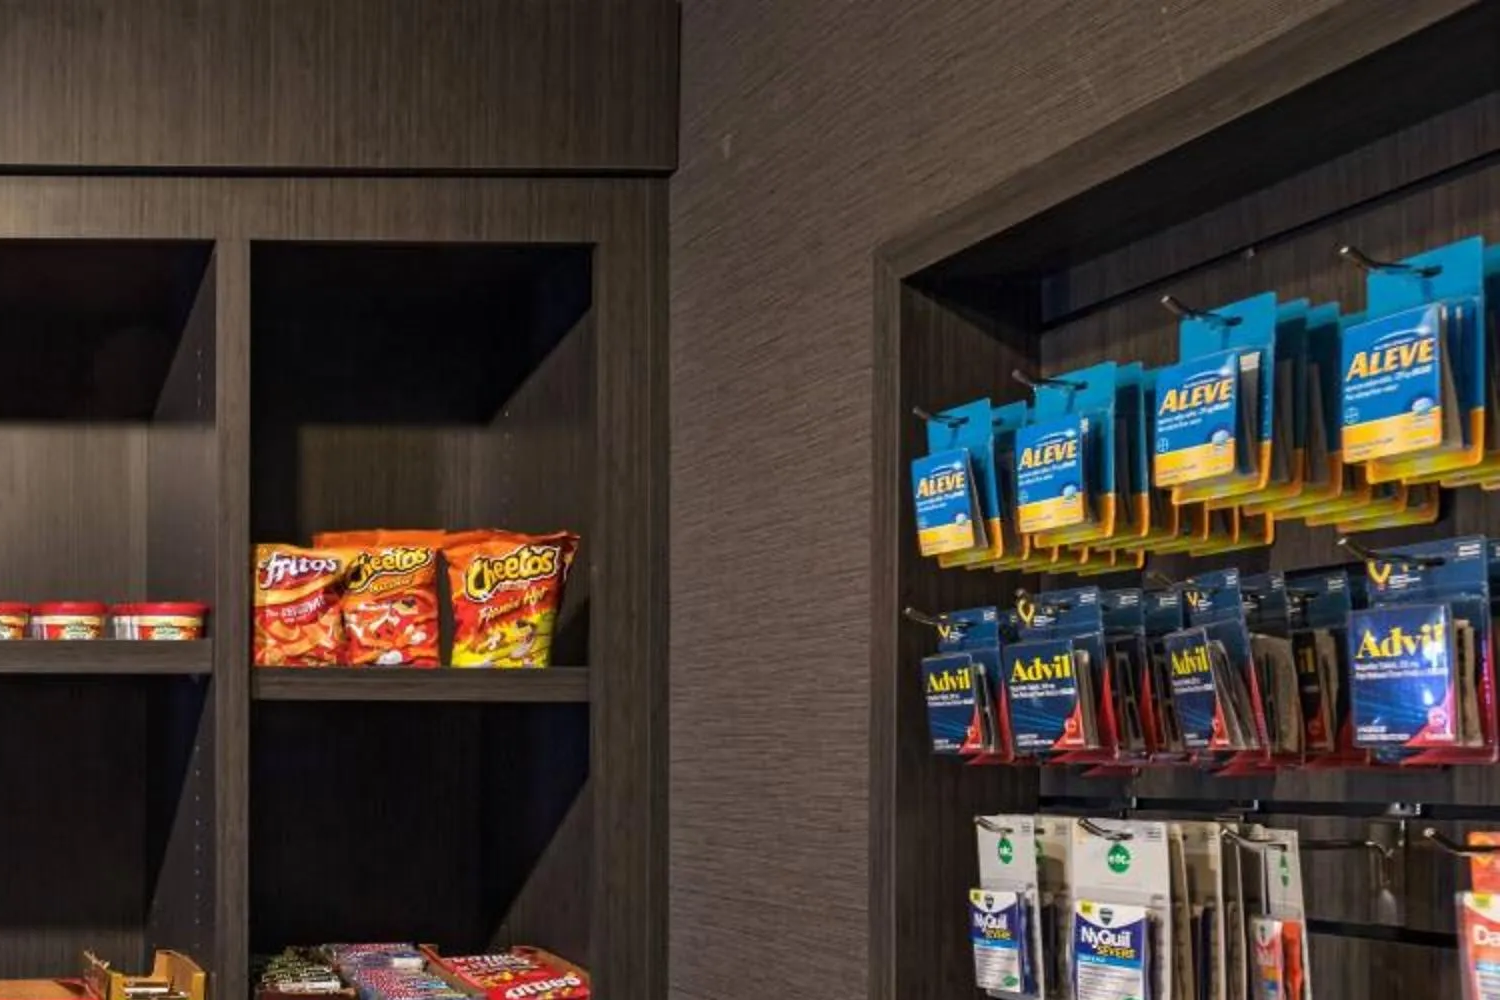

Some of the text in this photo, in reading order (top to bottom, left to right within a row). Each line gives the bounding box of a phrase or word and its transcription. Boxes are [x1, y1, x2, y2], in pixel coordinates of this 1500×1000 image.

[1346, 338, 1436, 382] ALEVE
[1158, 378, 1234, 416] ALEVE
[1018, 439, 1077, 470] ALEVE
[916, 472, 965, 498] ALEVE
[466, 547, 556, 600] Cheetos
[1355, 622, 1445, 657] Advil
[1011, 654, 1071, 682] Advil
[1171, 646, 1209, 676] Advil
[927, 667, 971, 692] Advil
[1080, 926, 1133, 949] NyQuil
